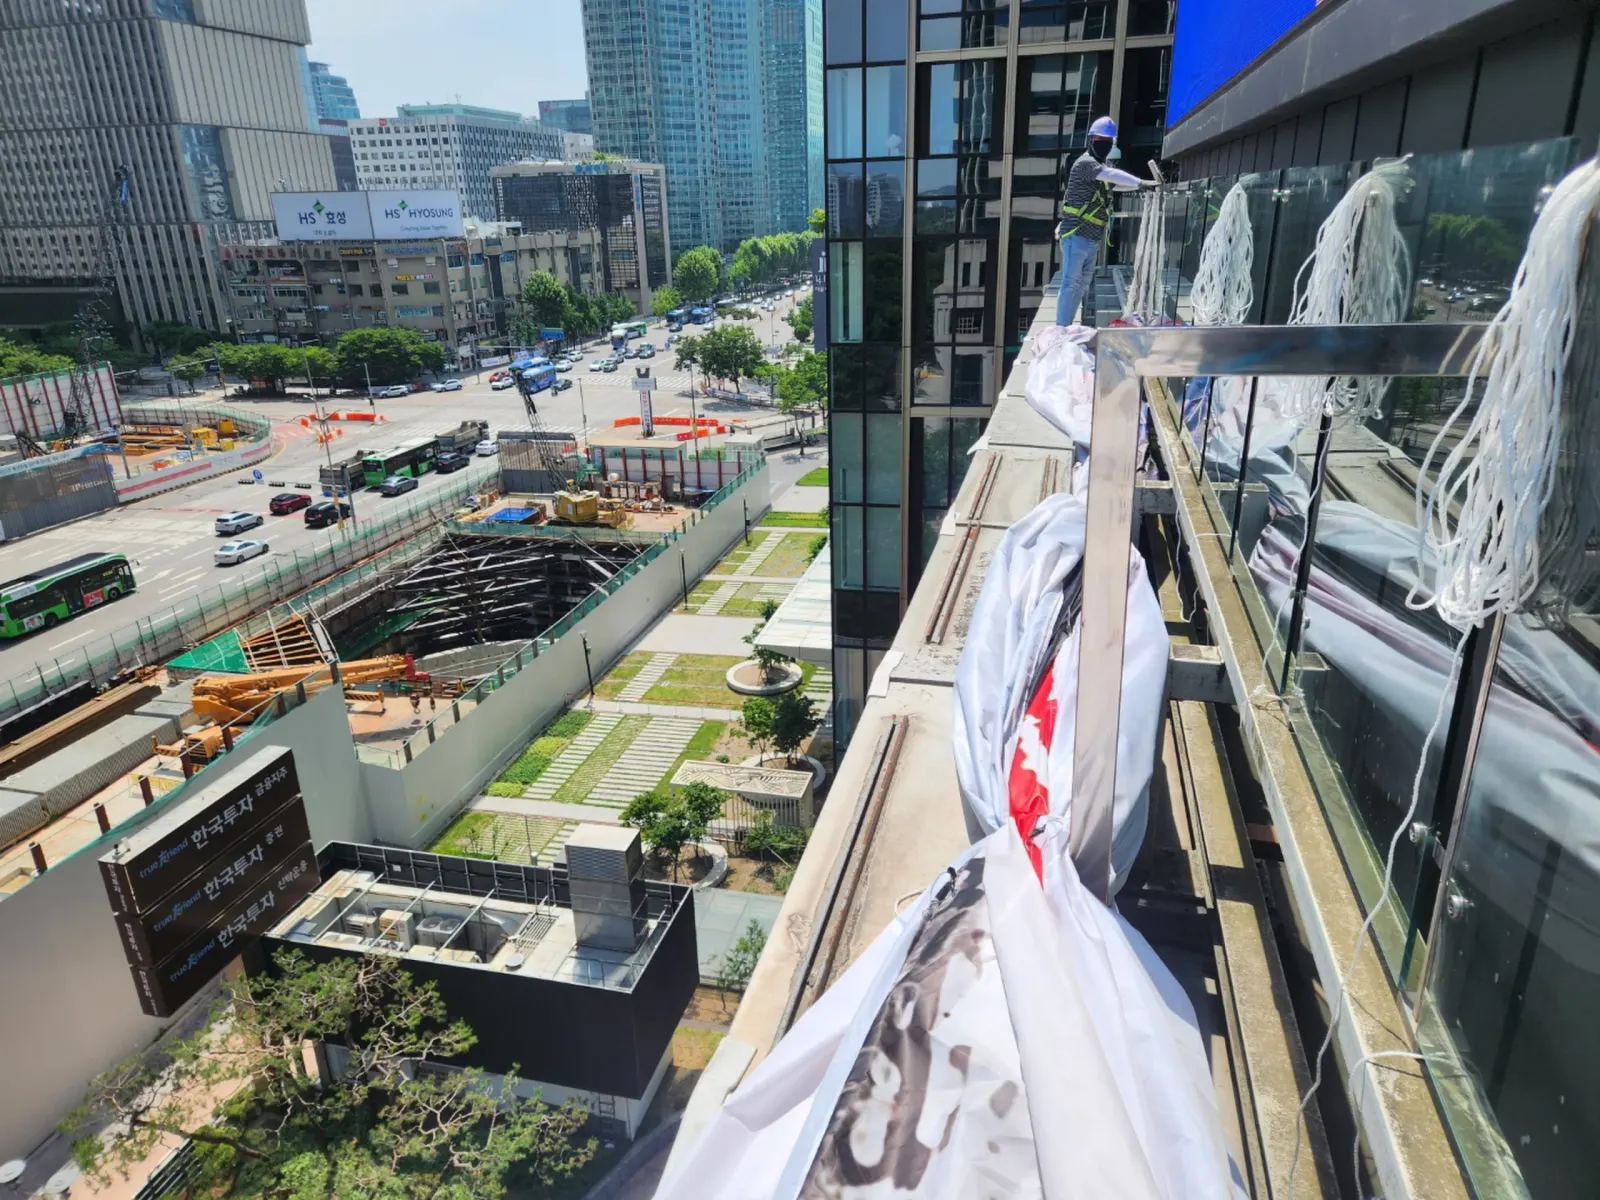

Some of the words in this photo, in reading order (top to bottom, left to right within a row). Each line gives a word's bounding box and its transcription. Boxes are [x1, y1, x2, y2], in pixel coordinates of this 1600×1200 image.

[298, 211, 316, 225] HS
[325, 211, 347, 225] 효성
[384, 208, 401, 219] HS
[408, 207, 454, 218] HYOSUNG
[190, 793, 253, 850] 한국투자
[255, 766, 288, 797] 금융지주
[203, 844, 264, 900] 한국투자
[264, 824, 284, 845] 증권
[218, 890, 275, 948] 한국투자
